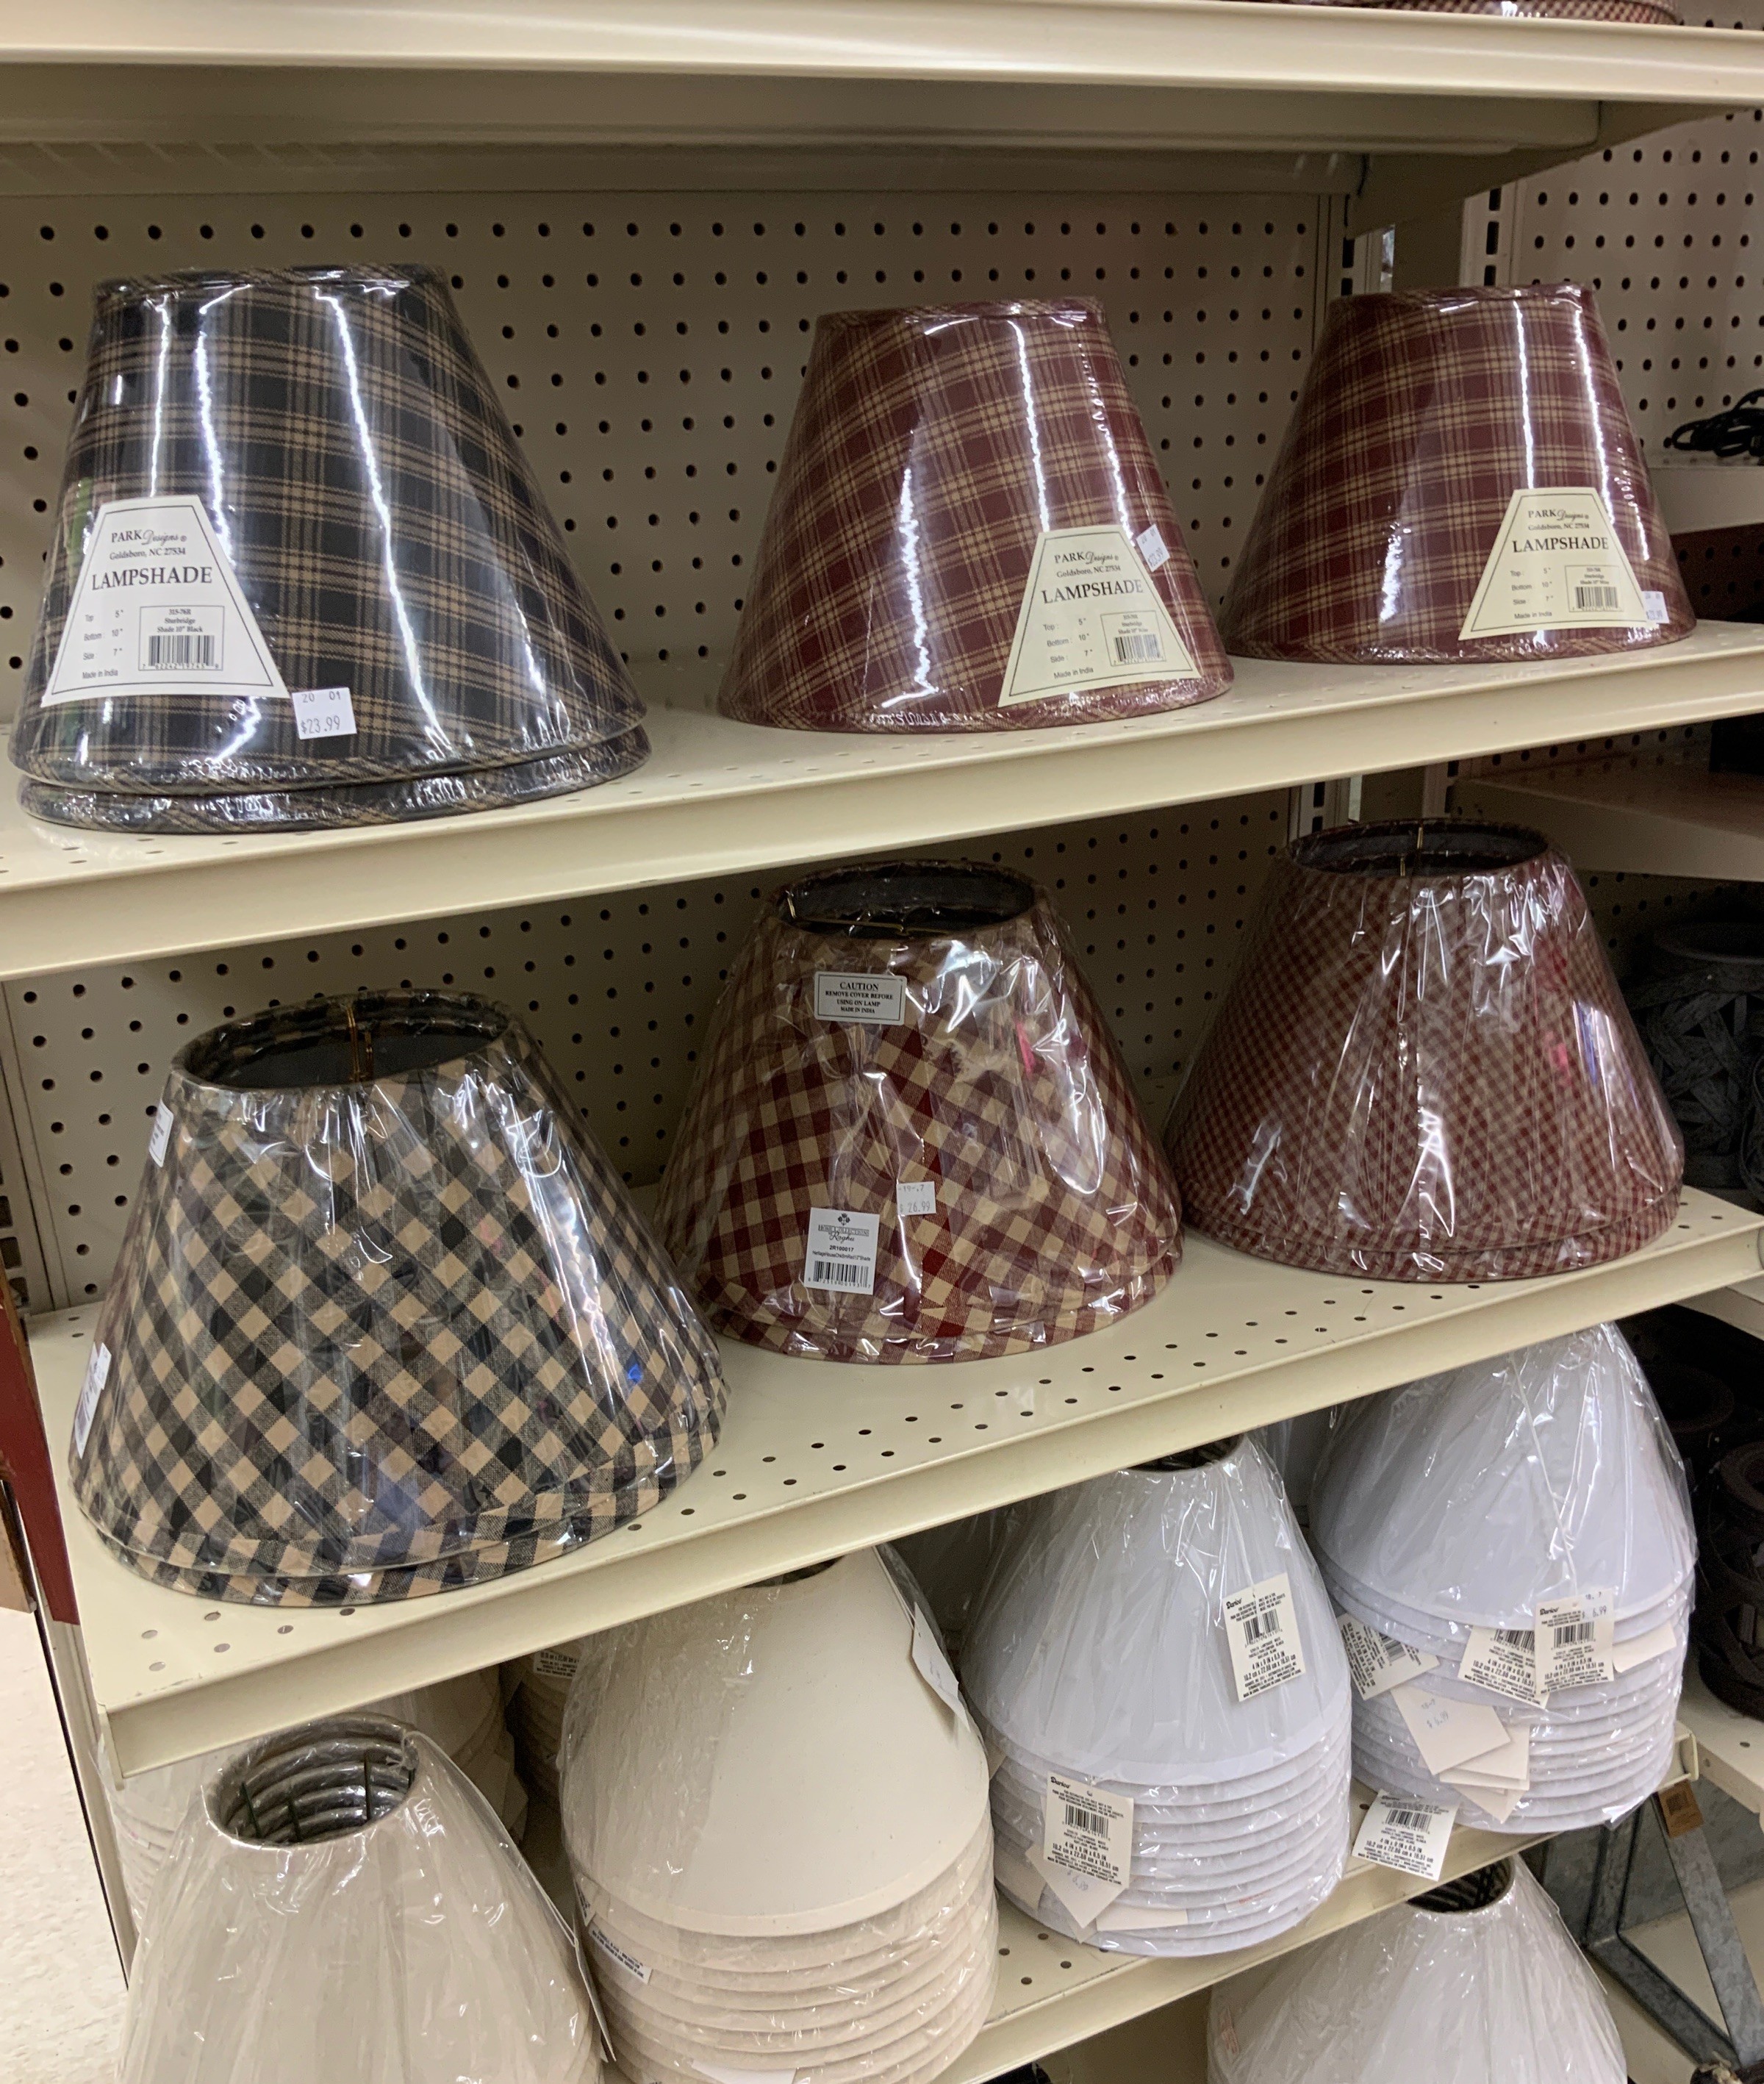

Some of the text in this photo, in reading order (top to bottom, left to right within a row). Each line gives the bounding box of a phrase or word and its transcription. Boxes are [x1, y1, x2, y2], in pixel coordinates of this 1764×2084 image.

[1528, 509, 1557, 518] PARK
[111, 529, 142, 543] PARK
[1512, 537, 1609, 553] LAMPSHADE
[110, 547, 186, 560] Goldsboro, NC 27534
[1054, 551, 1085, 564] PARK
[92, 566, 212, 591] LAMPSHADE
[1056, 567, 1091, 578] Goldsboro,
[1041, 579, 1143, 604] LAMPSHADE
[301, 715, 341, 734] $23.99
[839, 981, 879, 992] CAUTION
